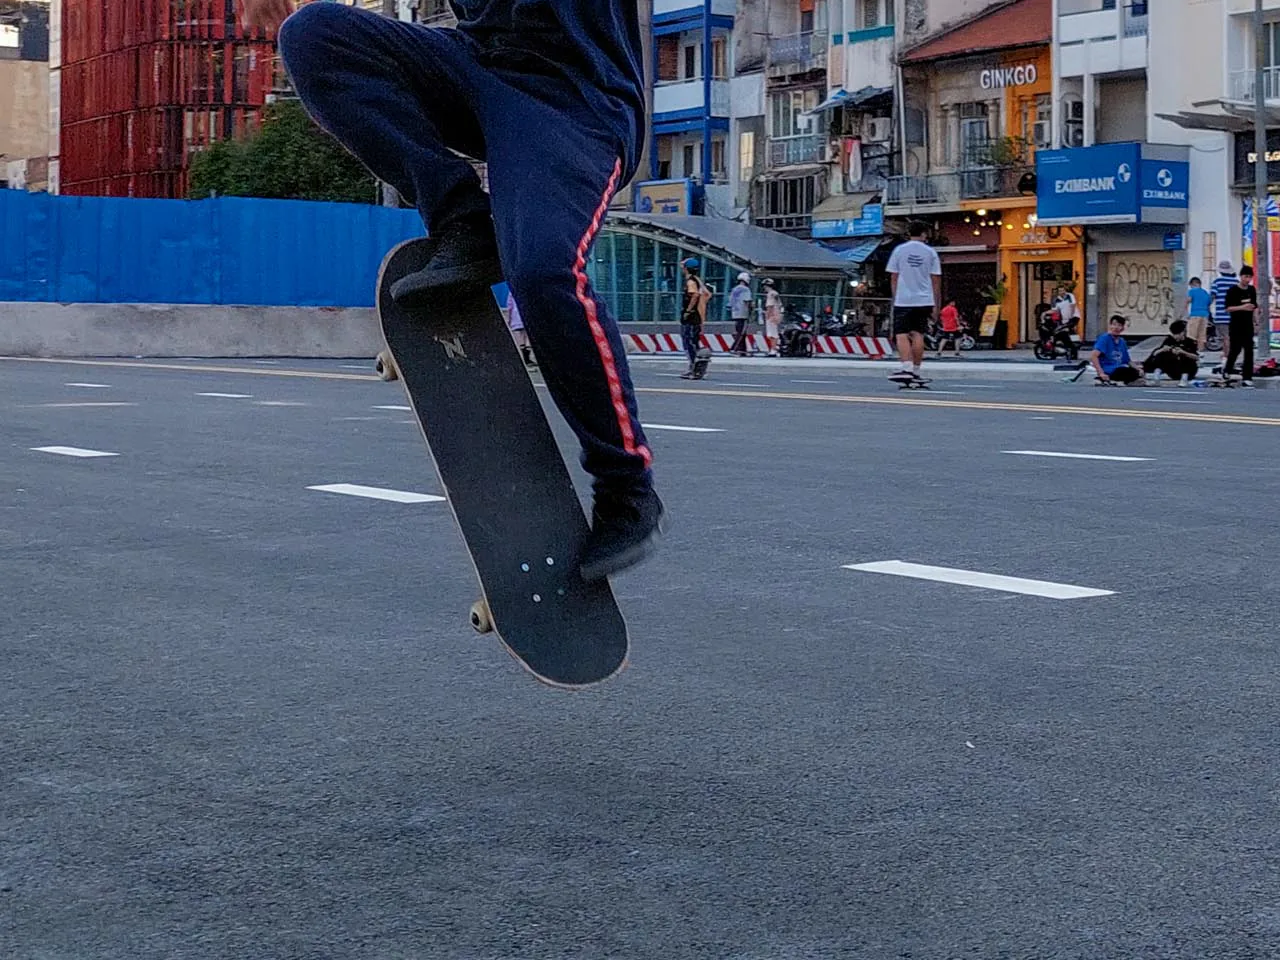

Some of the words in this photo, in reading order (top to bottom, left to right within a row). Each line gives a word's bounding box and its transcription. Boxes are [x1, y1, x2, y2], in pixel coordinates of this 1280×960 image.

[980, 64, 1037, 89] GINKGO
[1054, 176, 1116, 194] EXIMBANK
[1143, 189, 1186, 201] EXIMBANK
